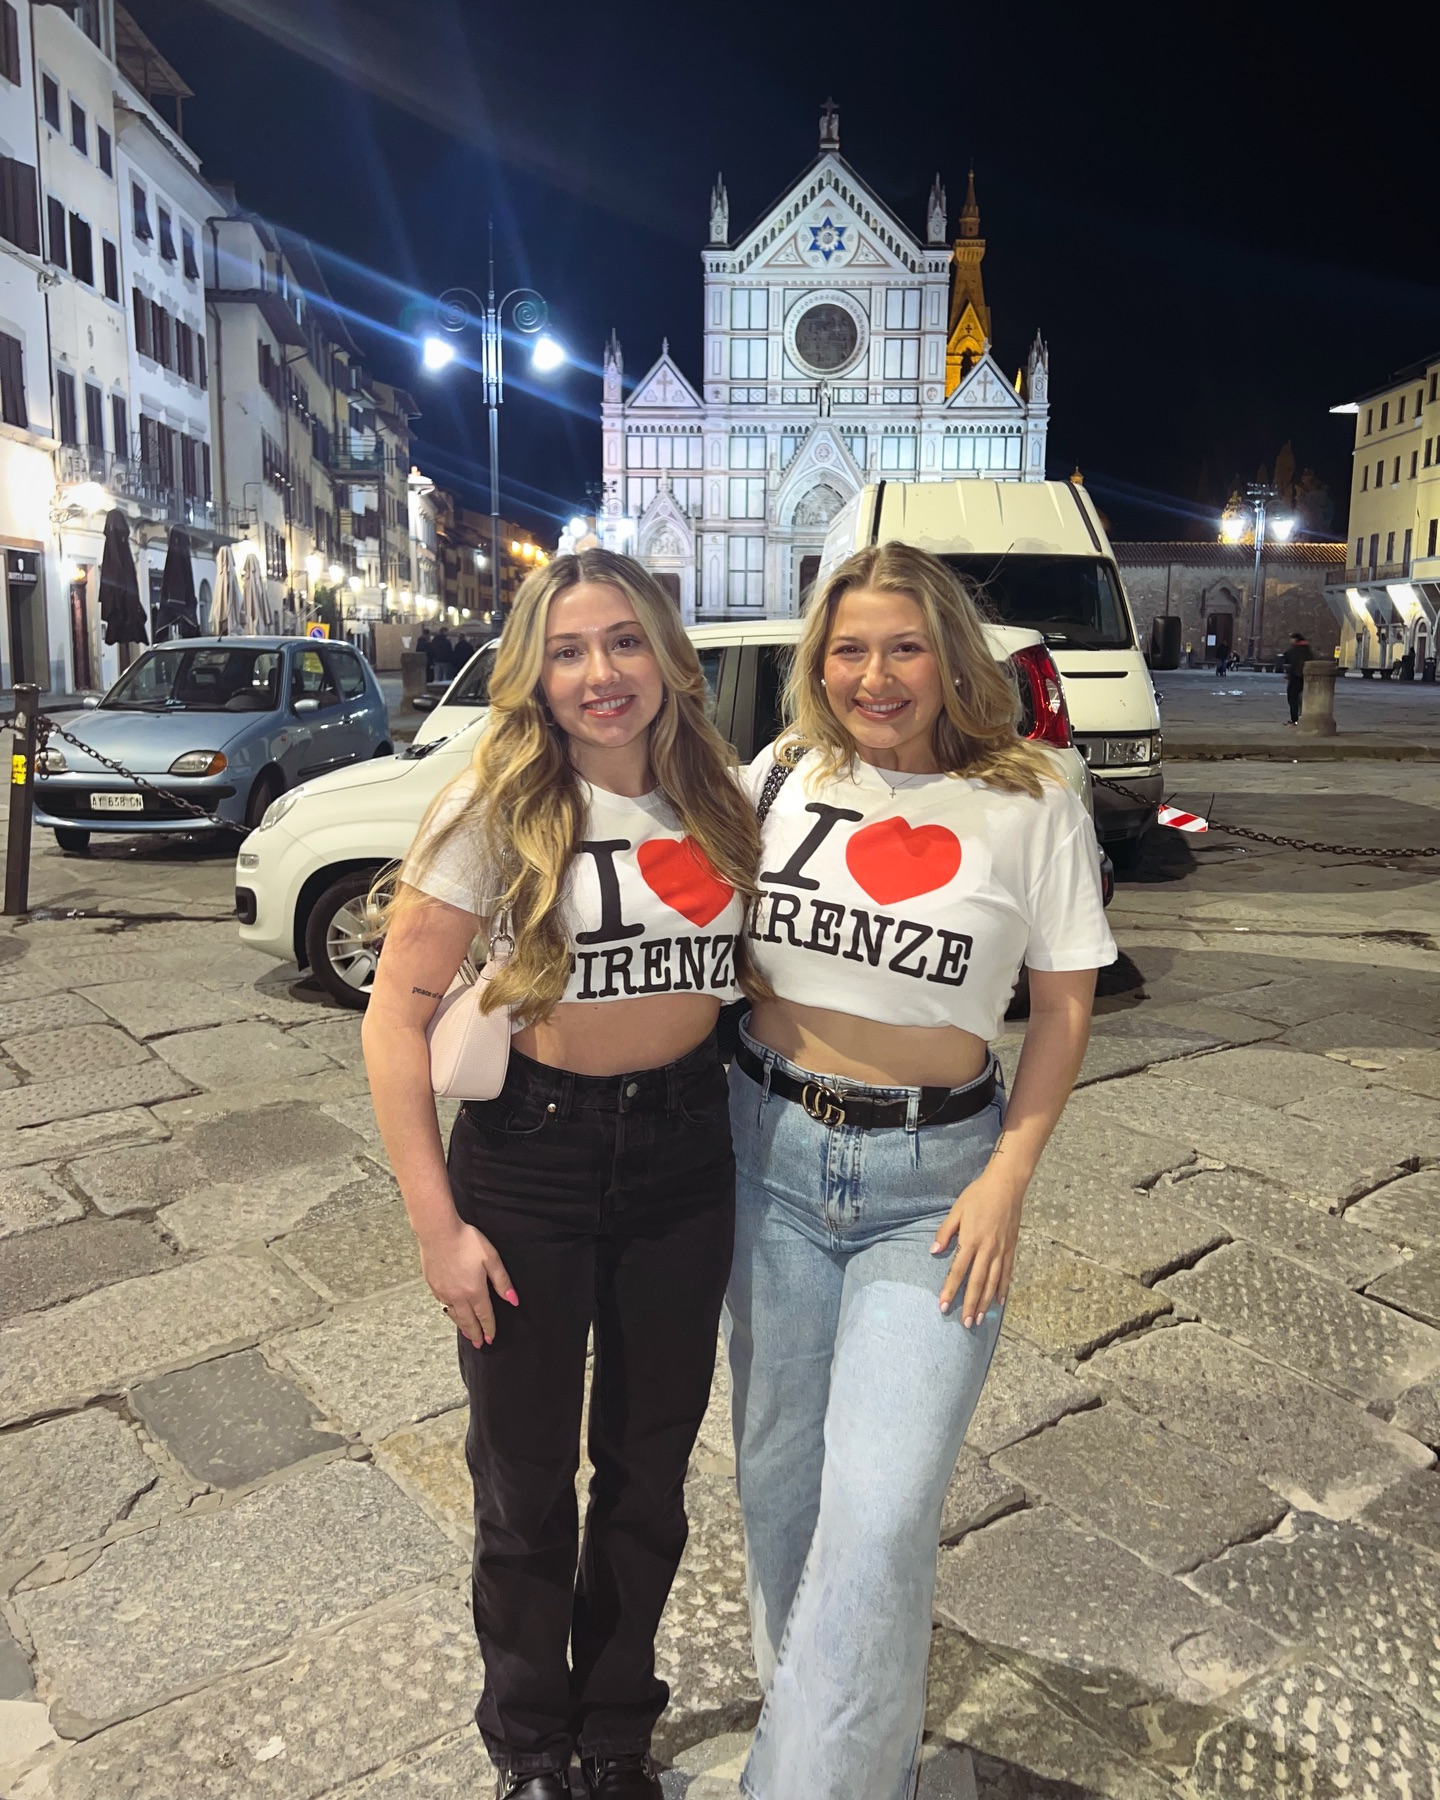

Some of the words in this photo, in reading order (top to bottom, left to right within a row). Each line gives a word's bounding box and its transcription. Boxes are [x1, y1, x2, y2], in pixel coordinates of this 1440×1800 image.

[575, 839, 646, 945] I
[759, 802, 864, 891] I
[568, 934, 737, 1000] IRENZ
[747, 890, 974, 987] IRENZE
